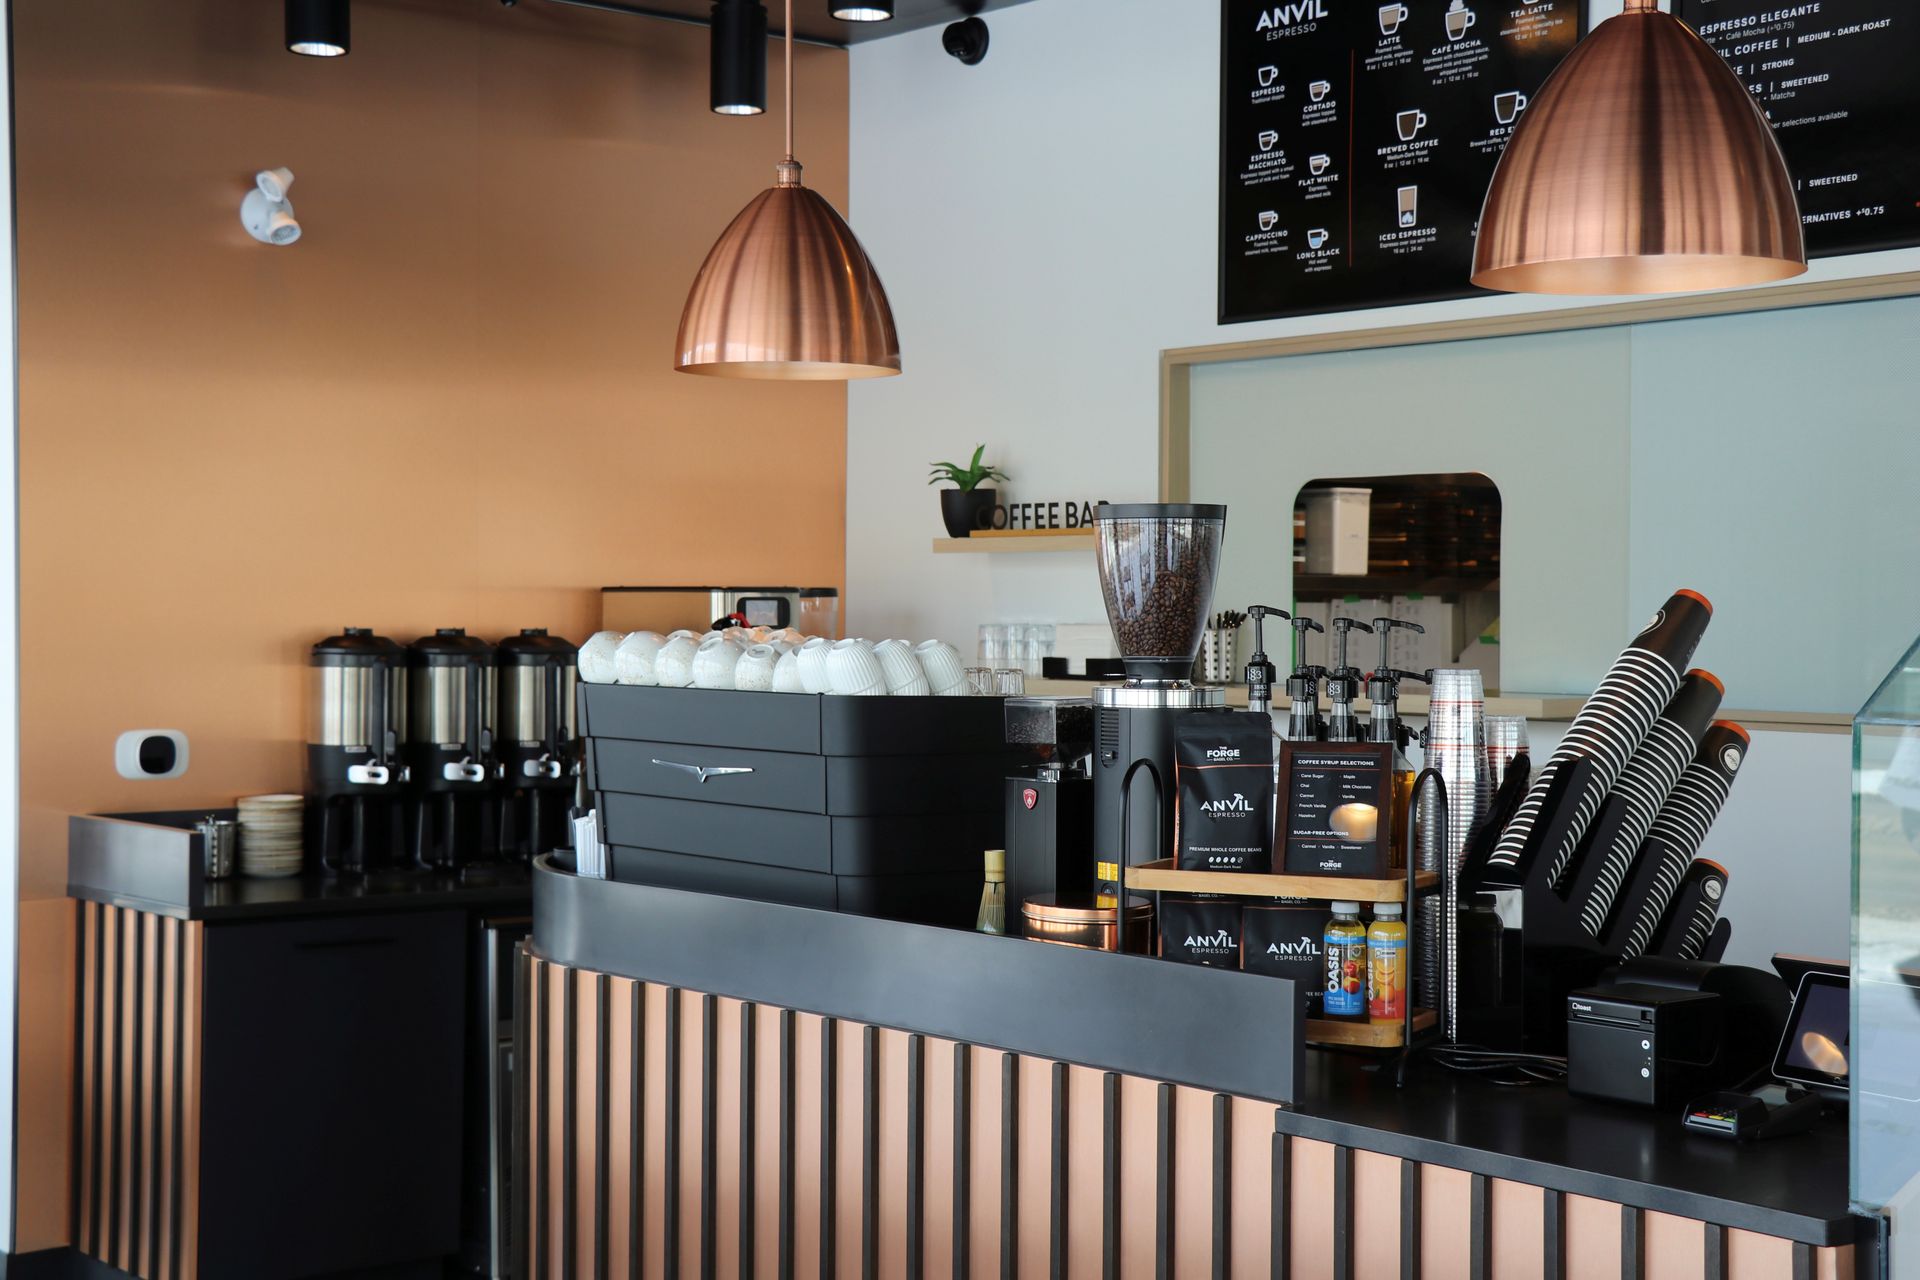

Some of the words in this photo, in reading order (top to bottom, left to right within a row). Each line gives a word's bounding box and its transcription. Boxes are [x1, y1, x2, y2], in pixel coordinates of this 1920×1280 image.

[1256, 0, 1328, 32] ANVIL
[1510, 8, 1526, 18] TEA
[1528, 3, 1554, 15] LATTE
[1700, 15, 1756, 36] ESPRESSO
[1760, 3, 1821, 24] ELEGANTE
[1266, 22, 1317, 41] ESPRESSO
[1734, 38, 1779, 55] COFFEE
[1797, 30, 1830, 44] MEDIUM
[1837, 25, 1861, 37] DARK
[1862, 18, 1891, 32] ROAST
[1742, 27, 1766, 38] Mocha
[1378, 36, 1400, 47] LATTE
[1431, 44, 1452, 56] CAFÉ
[1453, 39, 1481, 51] MOCHA
[1761, 58, 1795, 71] STRONG
[1780, 73, 1829, 89] SWEETENED
[1251, 85, 1286, 98] ESPRESSO
[1770, 90, 1796, 101] Matcha
[1303, 101, 1337, 113] CORTADO
[1782, 116, 1816, 128] selections
[1817, 110, 1849, 122] available
[1489, 127, 1505, 137] RED
[1377, 143, 1407, 155] BREWED
[1409, 138, 1439, 150] COFFEE
[1250, 150, 1285, 162] ESPRESSO
[1248, 158, 1287, 171] MACCHIATO
[1298, 178, 1315, 187] FLAT
[1317, 174, 1339, 184] WHITE
[1808, 173, 1858, 187] SWEETENED
[1802, 210, 1851, 224] ERNATIVES
[1245, 230, 1288, 242] CAPPUCCINO
[1379, 230, 1397, 241] ICED
[1398, 227, 1437, 239] ESPRESSO
[1296, 250, 1316, 260] LONG
[1317, 248, 1340, 257] BLACK
[1065, 500, 1110, 529] BA
[1206, 749, 1240, 758] FORGE
[1200, 793, 1254, 811] ANVIL
[1184, 930, 1237, 948] ANVIL
[1266, 937, 1321, 955] ANVIL
[1327, 947, 1340, 993] OASIS
